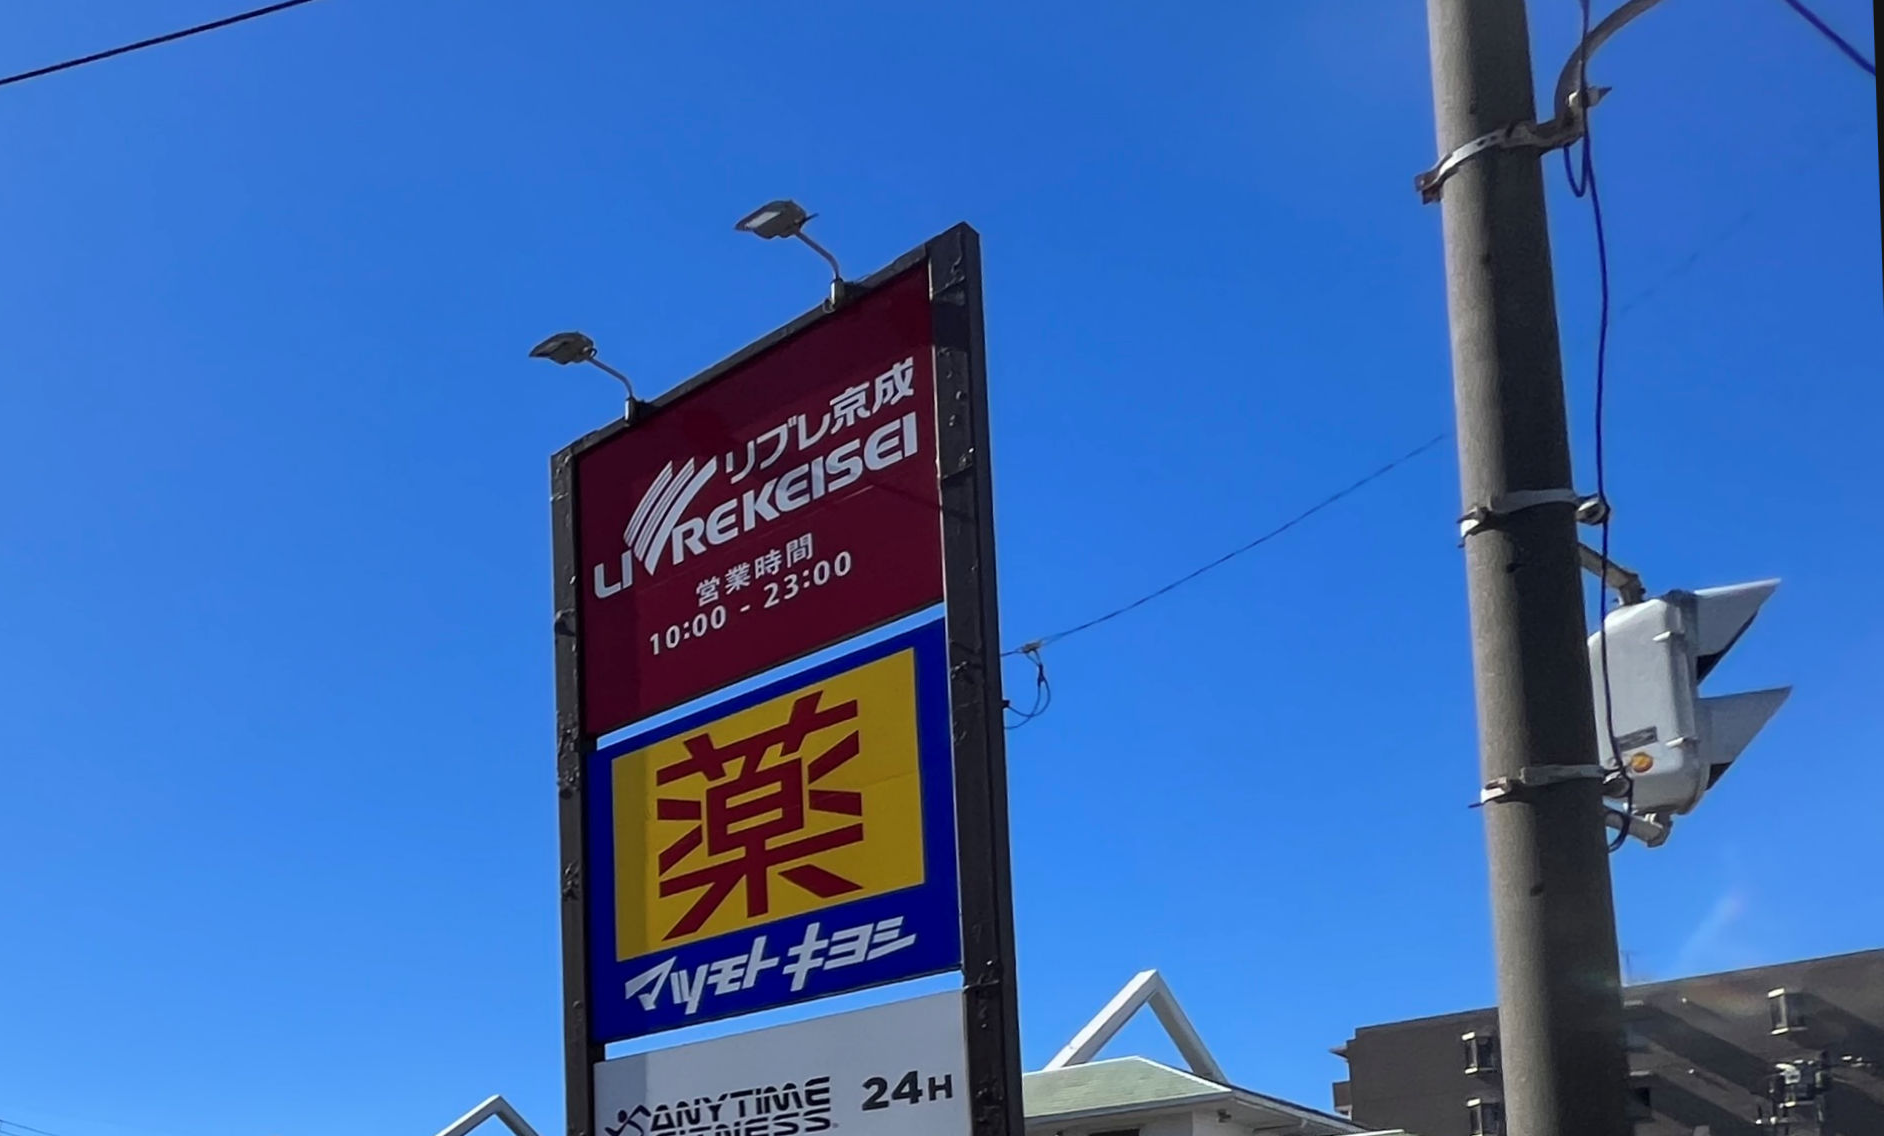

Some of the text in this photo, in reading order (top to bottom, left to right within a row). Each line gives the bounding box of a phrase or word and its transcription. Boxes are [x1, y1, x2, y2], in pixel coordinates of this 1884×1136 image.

[725, 357, 915, 484] リブレ京成
[649, 603, 727, 655] 10:00
[763, 551, 852, 609] 23:00
[696, 532, 814, 606] 営業時間
[656, 689, 865, 941] 薬
[624, 915, 917, 1015] マツモトキヨシ
[650, 1076, 831, 1132] ANYTIME
